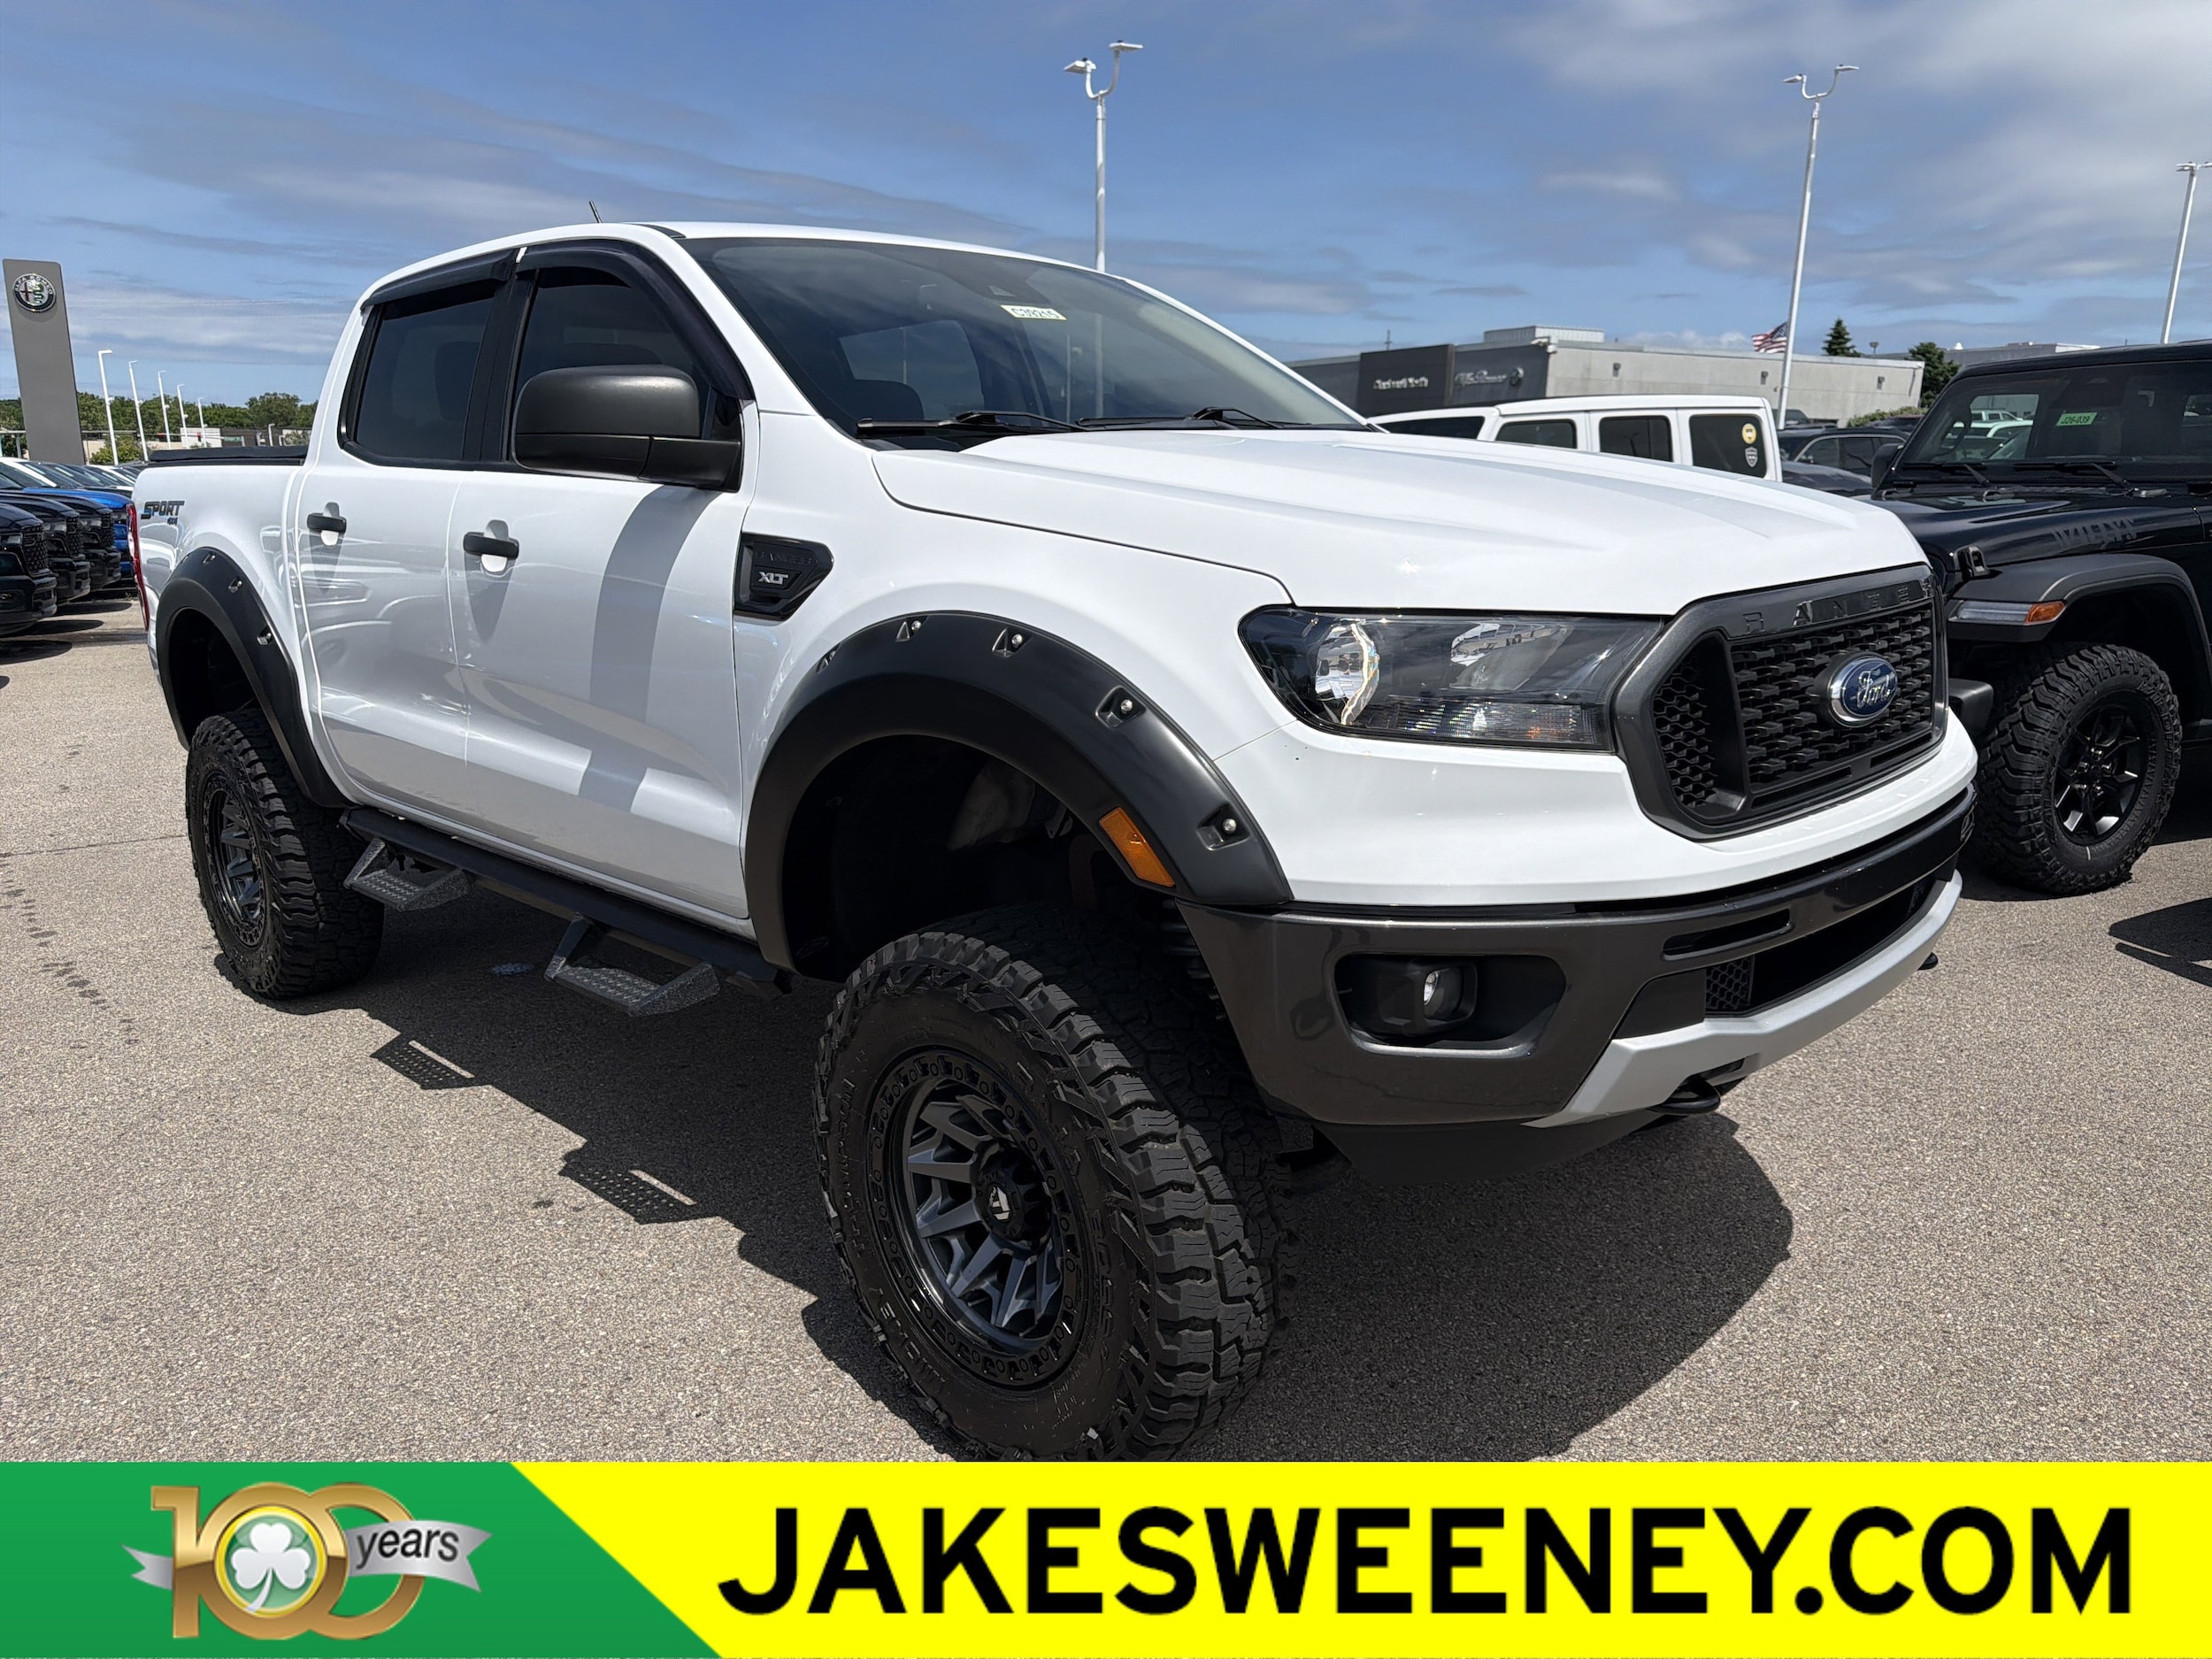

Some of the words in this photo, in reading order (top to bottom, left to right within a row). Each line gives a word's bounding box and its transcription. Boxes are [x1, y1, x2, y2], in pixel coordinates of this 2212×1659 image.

[29, 275, 53, 295] ROMEO
[141, 501, 185, 519] SPORT
[758, 571, 789, 585] XLT
[1855, 668, 1893, 709] Ford
